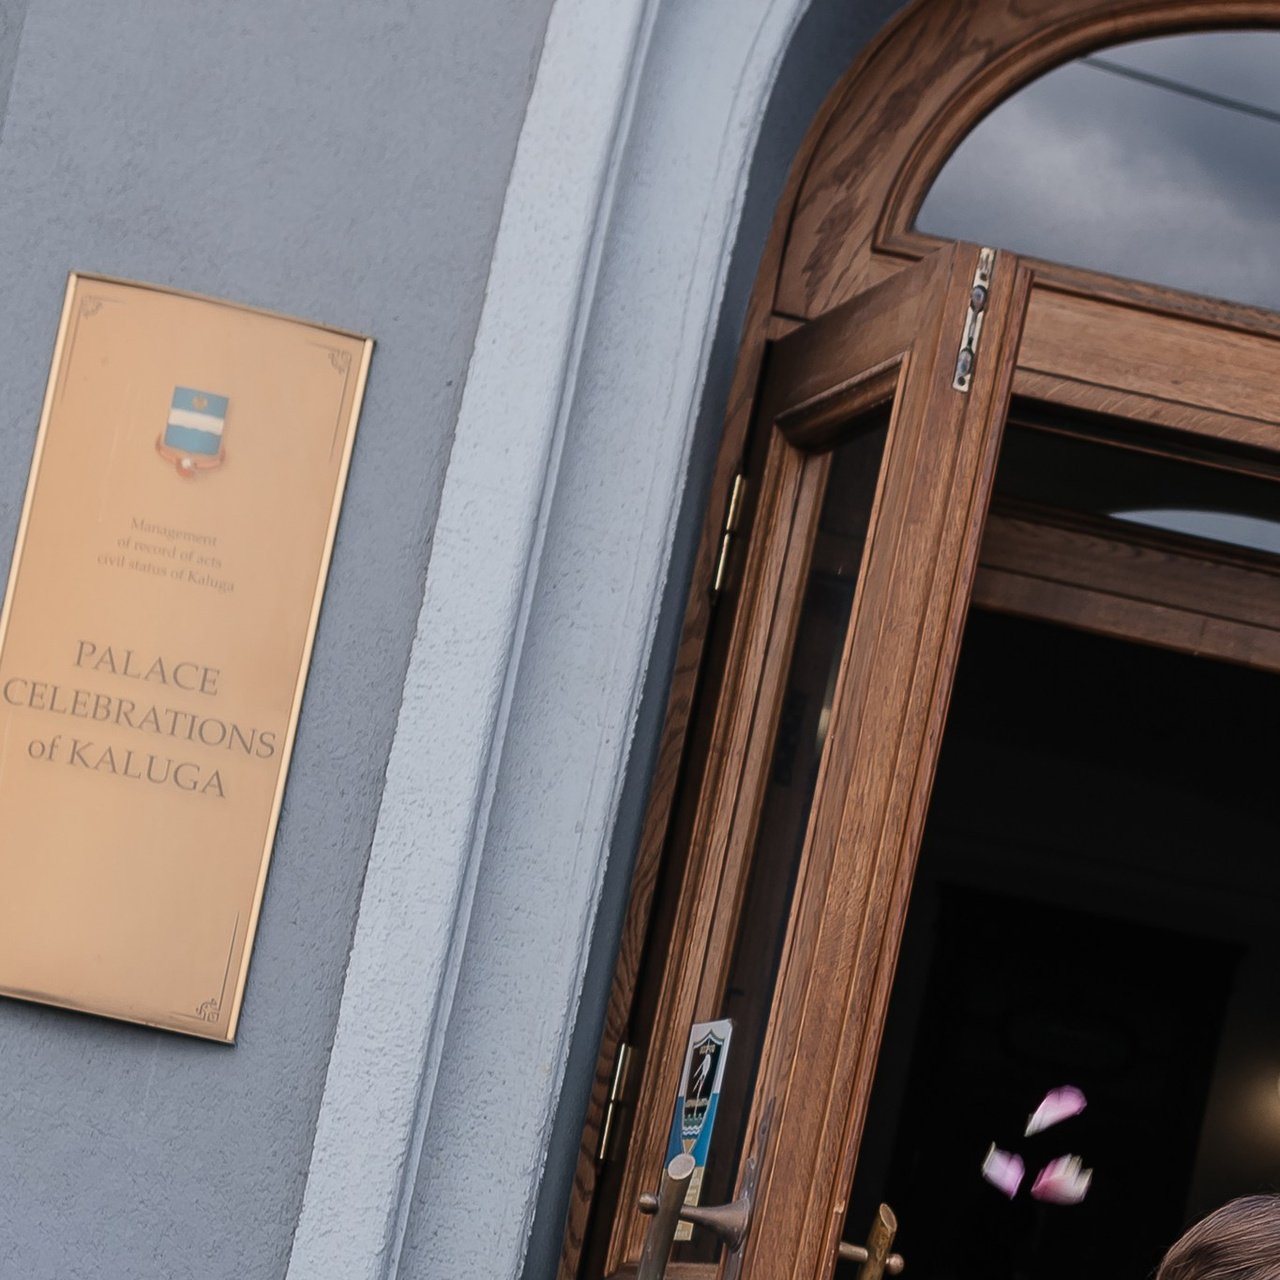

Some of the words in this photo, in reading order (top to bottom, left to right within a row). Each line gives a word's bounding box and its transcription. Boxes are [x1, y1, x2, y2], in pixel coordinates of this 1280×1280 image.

[117, 536, 131, 548] of
[134, 540, 177, 559] record
[179, 549, 194, 562] of
[197, 555, 222, 569] acts
[130, 516, 217, 547] Management
[97, 553, 125, 568] civil
[128, 560, 167, 577] status
[170, 568, 185, 580] of
[187, 569, 235, 593] Kaluga
[74, 639, 221, 697] PALACE
[2, 677, 277, 759] CELEBRATIONS
[27, 734, 62, 762] of
[67, 738, 226, 799] KALUGA
